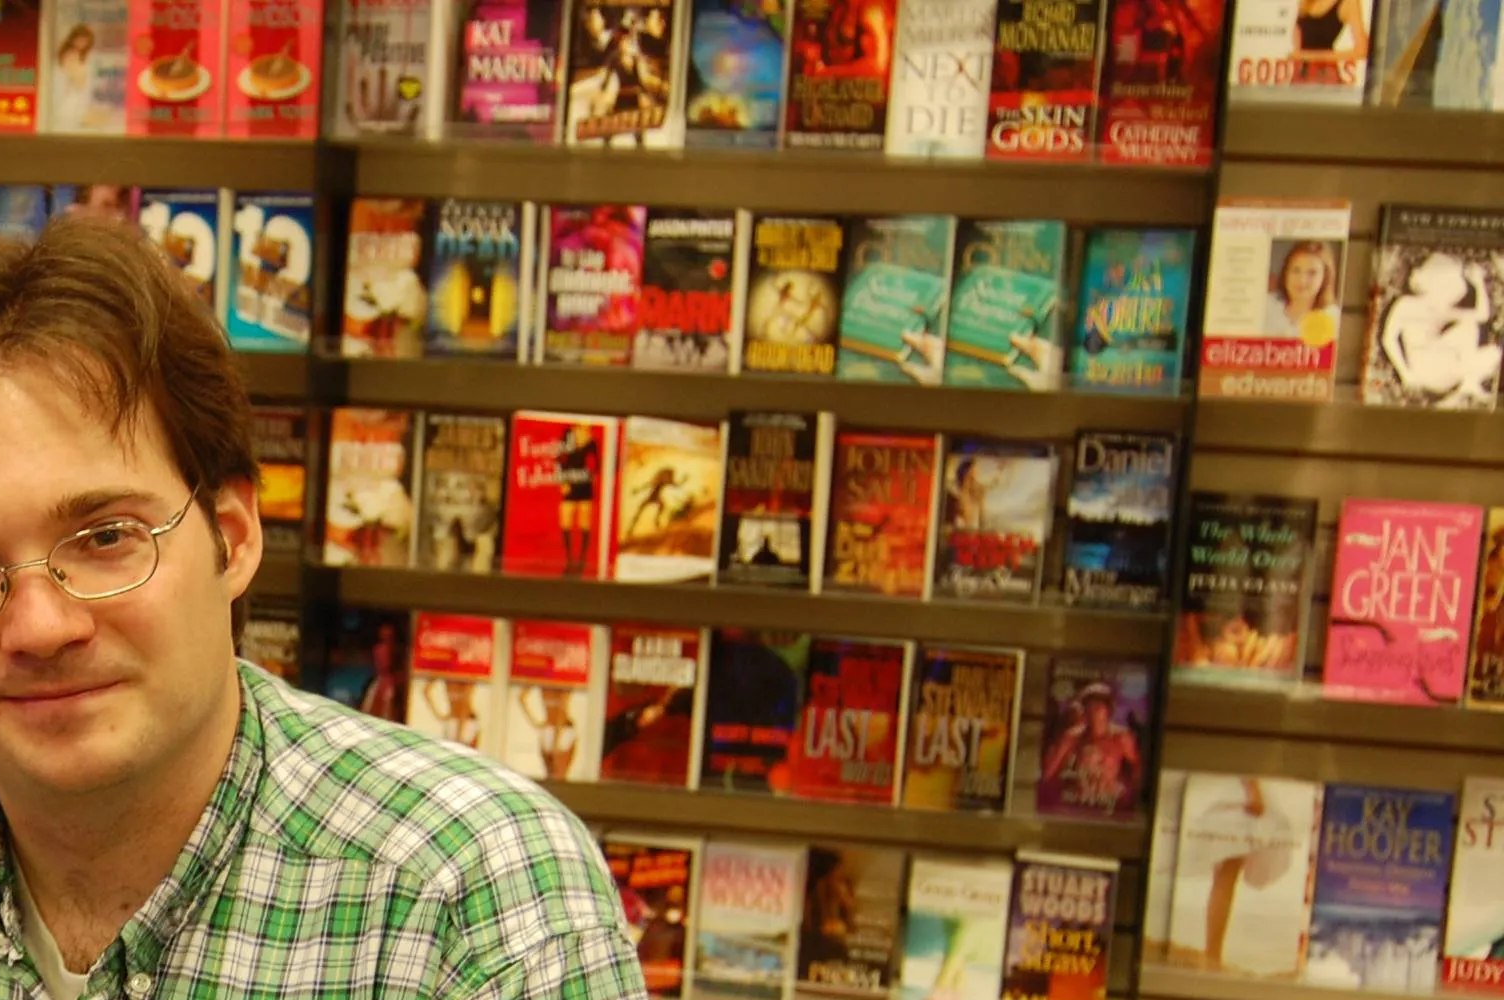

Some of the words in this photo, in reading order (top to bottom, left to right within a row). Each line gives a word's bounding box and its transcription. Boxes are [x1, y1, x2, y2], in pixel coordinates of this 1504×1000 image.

[471, 19, 516, 47] KAT
[468, 53, 556, 82] MARTIN
[901, 50, 989, 84] NEXT
[905, 106, 979, 137] DIE
[1021, 103, 1086, 129] SKIN
[991, 122, 1084, 153] GODS
[1206, 340, 1321, 370] elizabeth
[1219, 372, 1329, 396] edwards
[845, 445, 932, 474] JOHN
[1078, 440, 1173, 478] Daniel
[1200, 520, 1232, 541] The
[1239, 520, 1299, 545] Whole
[1378, 518, 1461, 574] JANE
[1341, 562, 1463, 626] GREEN
[805, 706, 873, 760] LAST
[915, 710, 985, 768] LAST
[1364, 795, 1414, 831] KAY
[1323, 821, 1444, 864] HOOPER
[1021, 866, 1111, 897] STUART
[1021, 893, 1107, 923] WOODS
[1025, 920, 1095, 953] Short
[1021, 945, 1098, 974] Straw
[1448, 957, 1504, 983] JUDY
